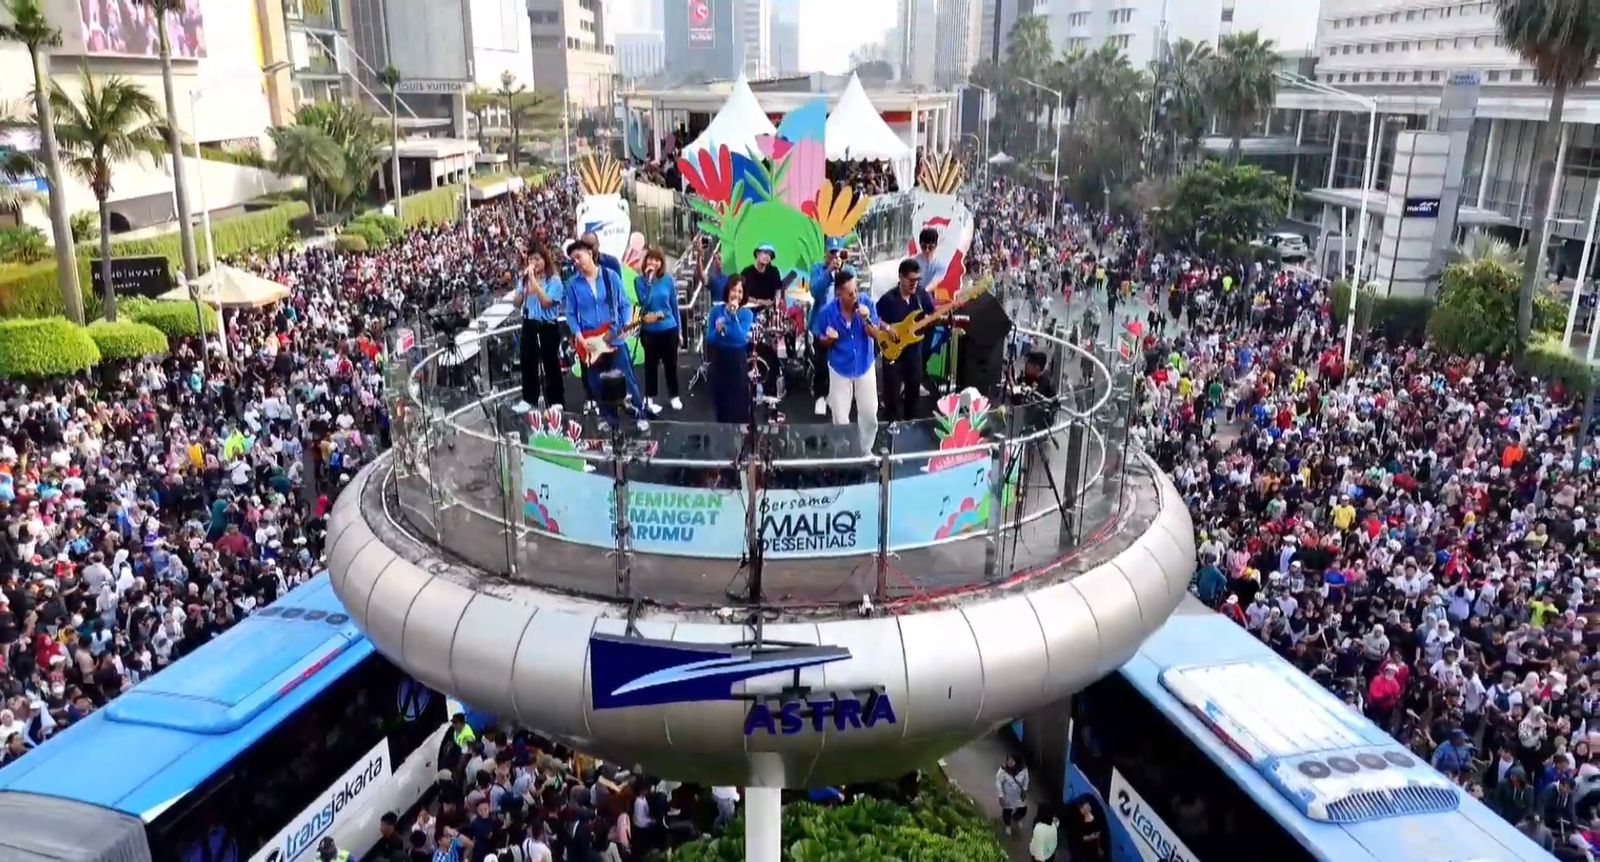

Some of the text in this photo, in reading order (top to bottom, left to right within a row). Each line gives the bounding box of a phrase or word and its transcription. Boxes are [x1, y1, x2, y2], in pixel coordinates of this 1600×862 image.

[128, 268, 161, 278] HYATT
[744, 694, 897, 736] ASTRA
[286, 756, 383, 860] transjakarta
